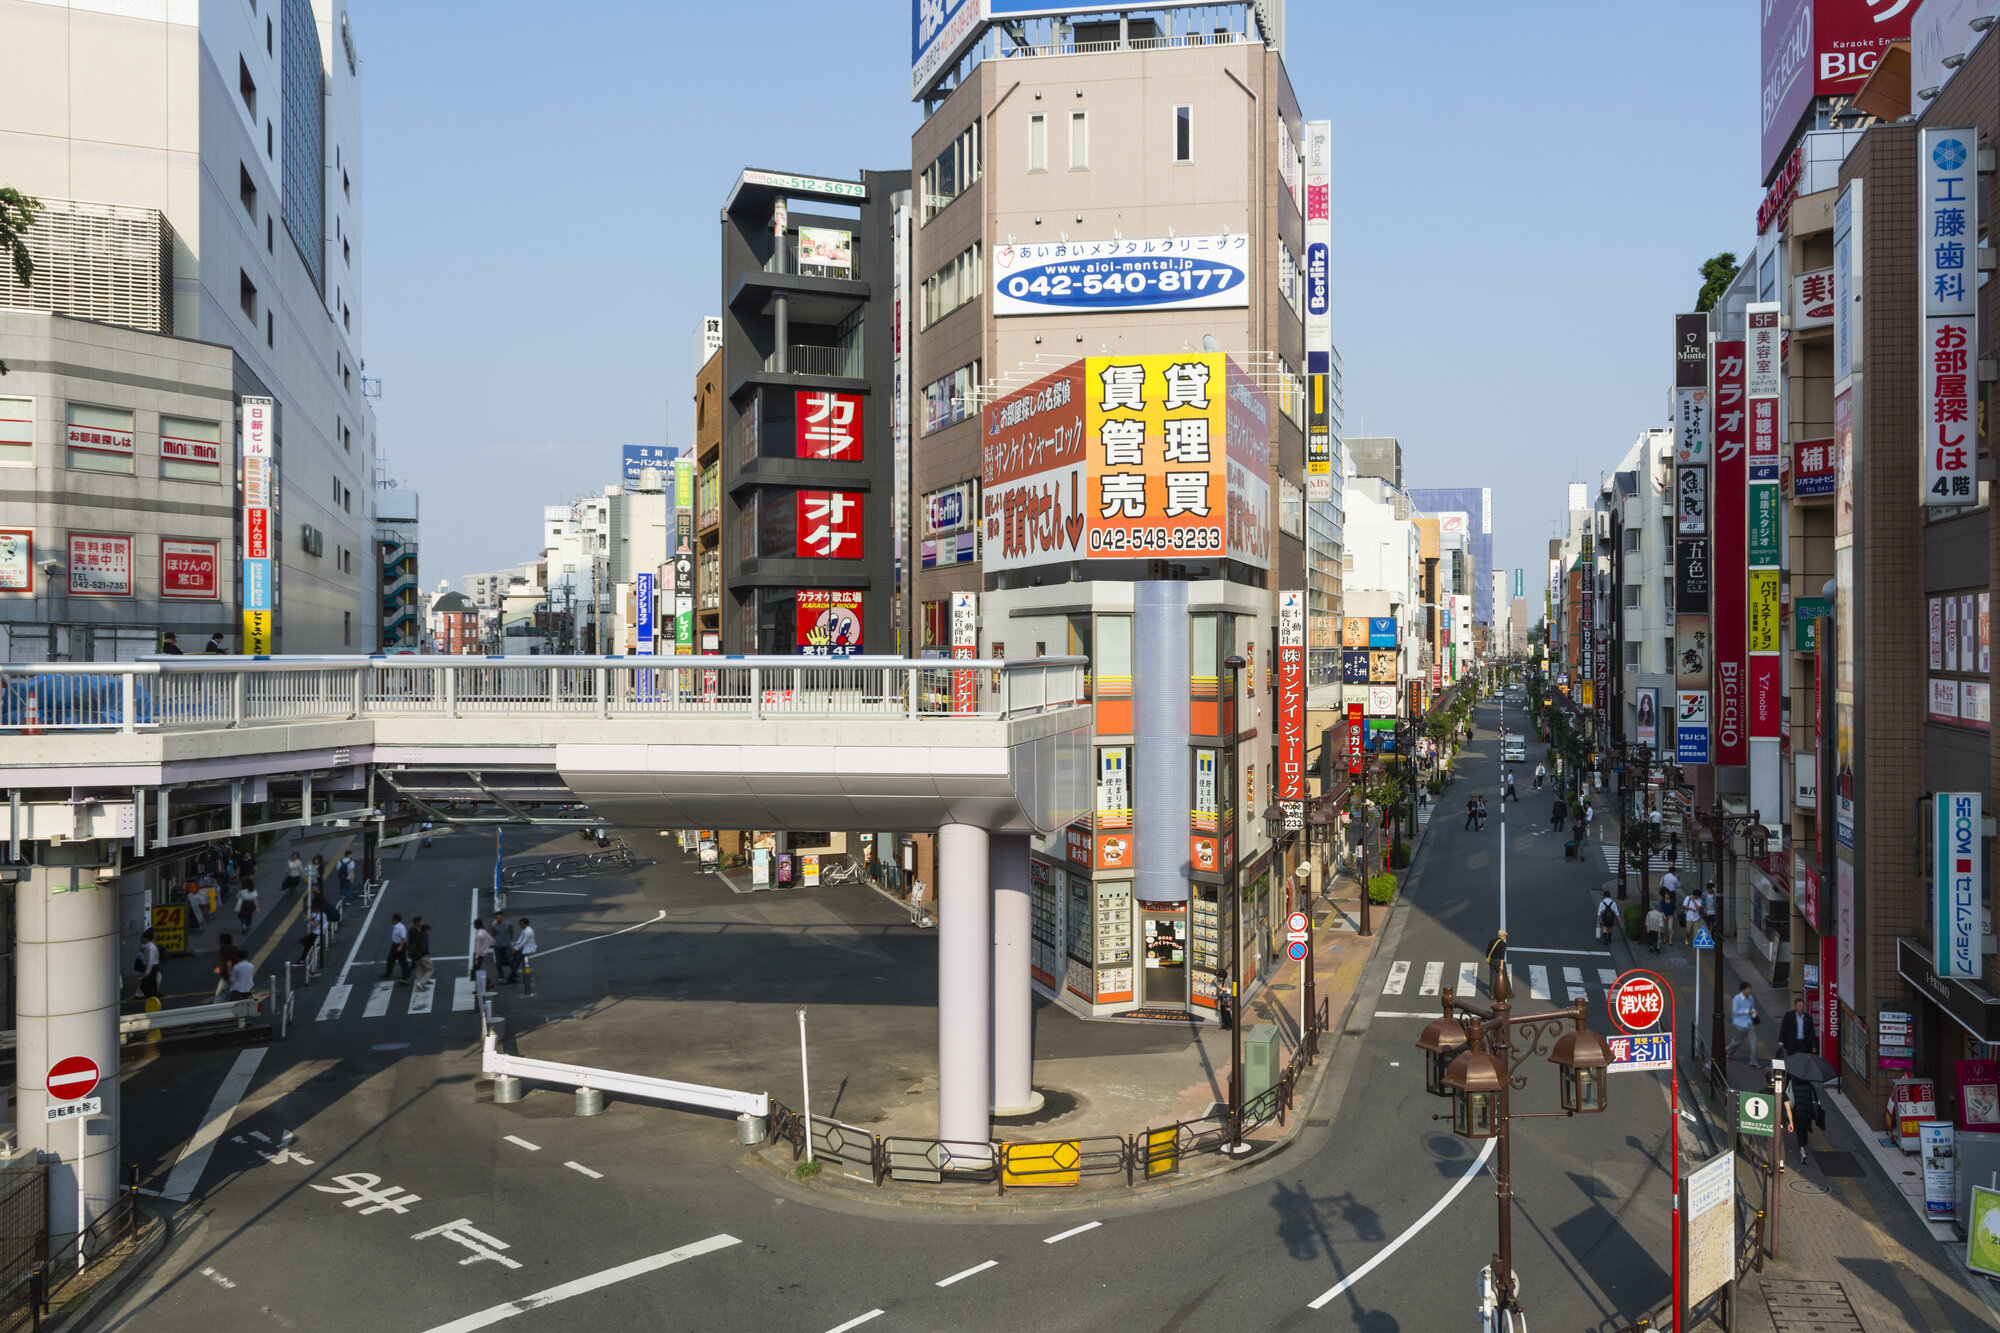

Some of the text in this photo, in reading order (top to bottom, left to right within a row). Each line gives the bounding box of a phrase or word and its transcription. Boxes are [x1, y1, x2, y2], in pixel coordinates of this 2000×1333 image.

[1833, 38, 1874, 48] Karaoke
[1764, 69, 1780, 136] BIG
[1781, 6, 1811, 80] ECHO
[1820, 51, 1876, 80] BIG
[1020, 237, 1246, 258] あいおいメンタルクリニック
[1934, 177, 1966, 302] 工藤歯科
[1009, 269, 1233, 297] 042-540-8177
[1045, 259, 1193, 274] www.aioi-mental.jp
[1311, 249, 1324, 309] Berlitz
[1756, 316, 1772, 327] 5F
[1678, 352, 1706, 360] Monte
[1757, 331, 1770, 373] 美容室
[1000, 378, 1071, 429] お部屋探しの名探偵
[1099, 362, 1211, 412] 賃貸
[1935, 325, 1968, 471] お部屋探しは
[805, 394, 854, 456] カラ
[1718, 355, 1744, 462] カラオケ
[69, 431, 132, 447] お部屋探しは
[252, 408, 264, 454] 日新ビル
[1099, 418, 1210, 466] 管理
[1756, 402, 1772, 451] 補聴器
[994, 415, 1083, 477] サンケイシャーロック
[1758, 468, 1770, 477] 4F
[1932, 476, 1970, 496] 4階
[985, 493, 1003, 518] 新しい
[1099, 472, 1212, 520] 売買
[252, 510, 262, 556] ほけんの窓口
[803, 494, 857, 556] オケ
[1003, 480, 1064, 560] 賃貸やさん
[1760, 490, 1770, 547] 健康スタジオ
[74, 541, 126, 554] 無料相談
[1090, 528, 1221, 552] 042-548-3233
[168, 560, 211, 572] ほけんの
[1686, 542, 1706, 578] 五色
[72, 580, 128, 590] 042-521-7351
[798, 592, 862, 603] カラオケ歌広場
[252, 612, 262, 636] JEANS
[680, 616, 689, 640] レイク
[954, 610, 964, 644] 総合商社
[965, 611, 974, 644] 不動産
[1281, 609, 1291, 645] 総合商社
[1293, 610, 1302, 645] 不動産
[1761, 582, 1772, 650] パワーステーション
[802, 646, 856, 656] 受付 4F
[1358, 656, 1367, 676] 九州
[1597, 644, 1606, 706] 東京アカデミー
[1720, 662, 1738, 747] BIG ECHO
[1956, 797, 1972, 854] SECOM
[155, 908, 182, 926] 24
[1292, 918, 1304, 928] 30
[1956, 876, 1973, 976] セコムショップ
[1621, 992, 1659, 1014] 消火栓
[1610, 1039, 1630, 1062] 質
[1630, 1042, 1668, 1062] 谷川
[48, 1102, 98, 1120] 自転車を除く
